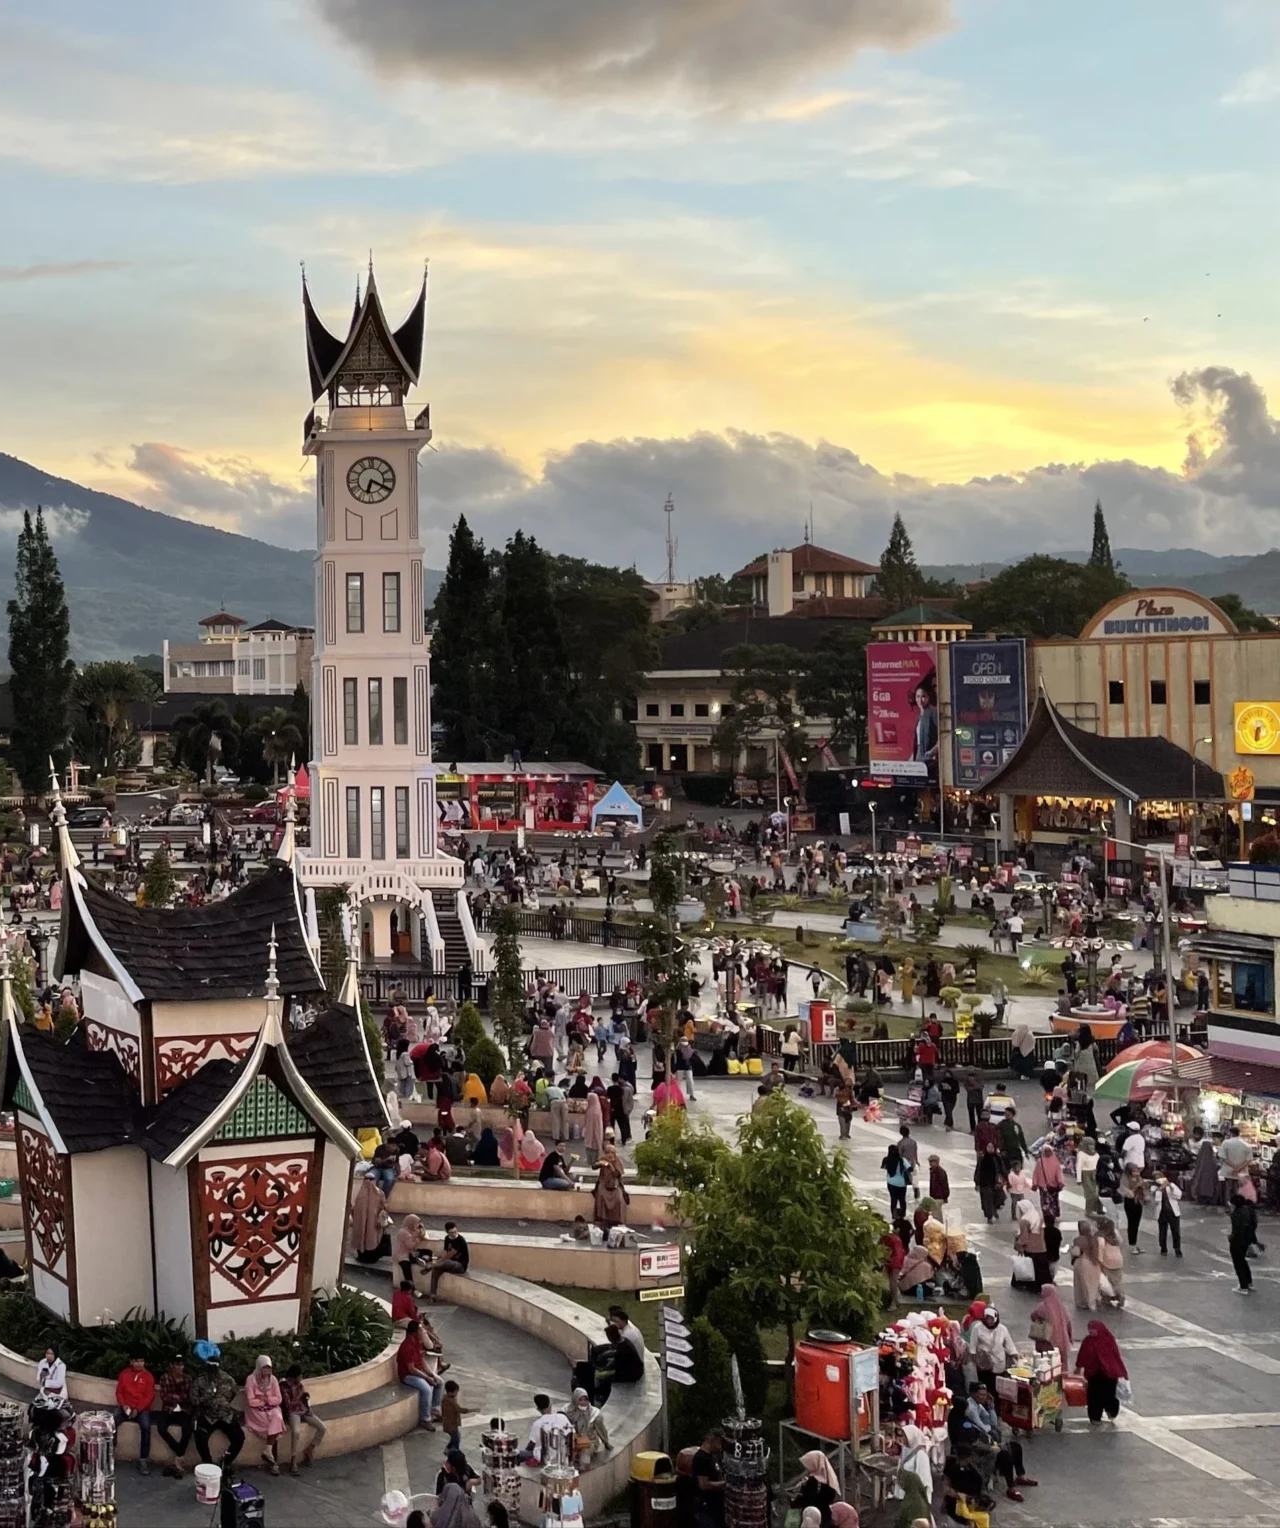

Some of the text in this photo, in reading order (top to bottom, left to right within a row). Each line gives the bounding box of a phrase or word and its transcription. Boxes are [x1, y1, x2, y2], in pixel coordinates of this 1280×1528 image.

[1135, 599, 1174, 616] Plaza
[1104, 616, 1209, 634] BUKITTINGGI
[972, 662, 1002, 675] OPEN
